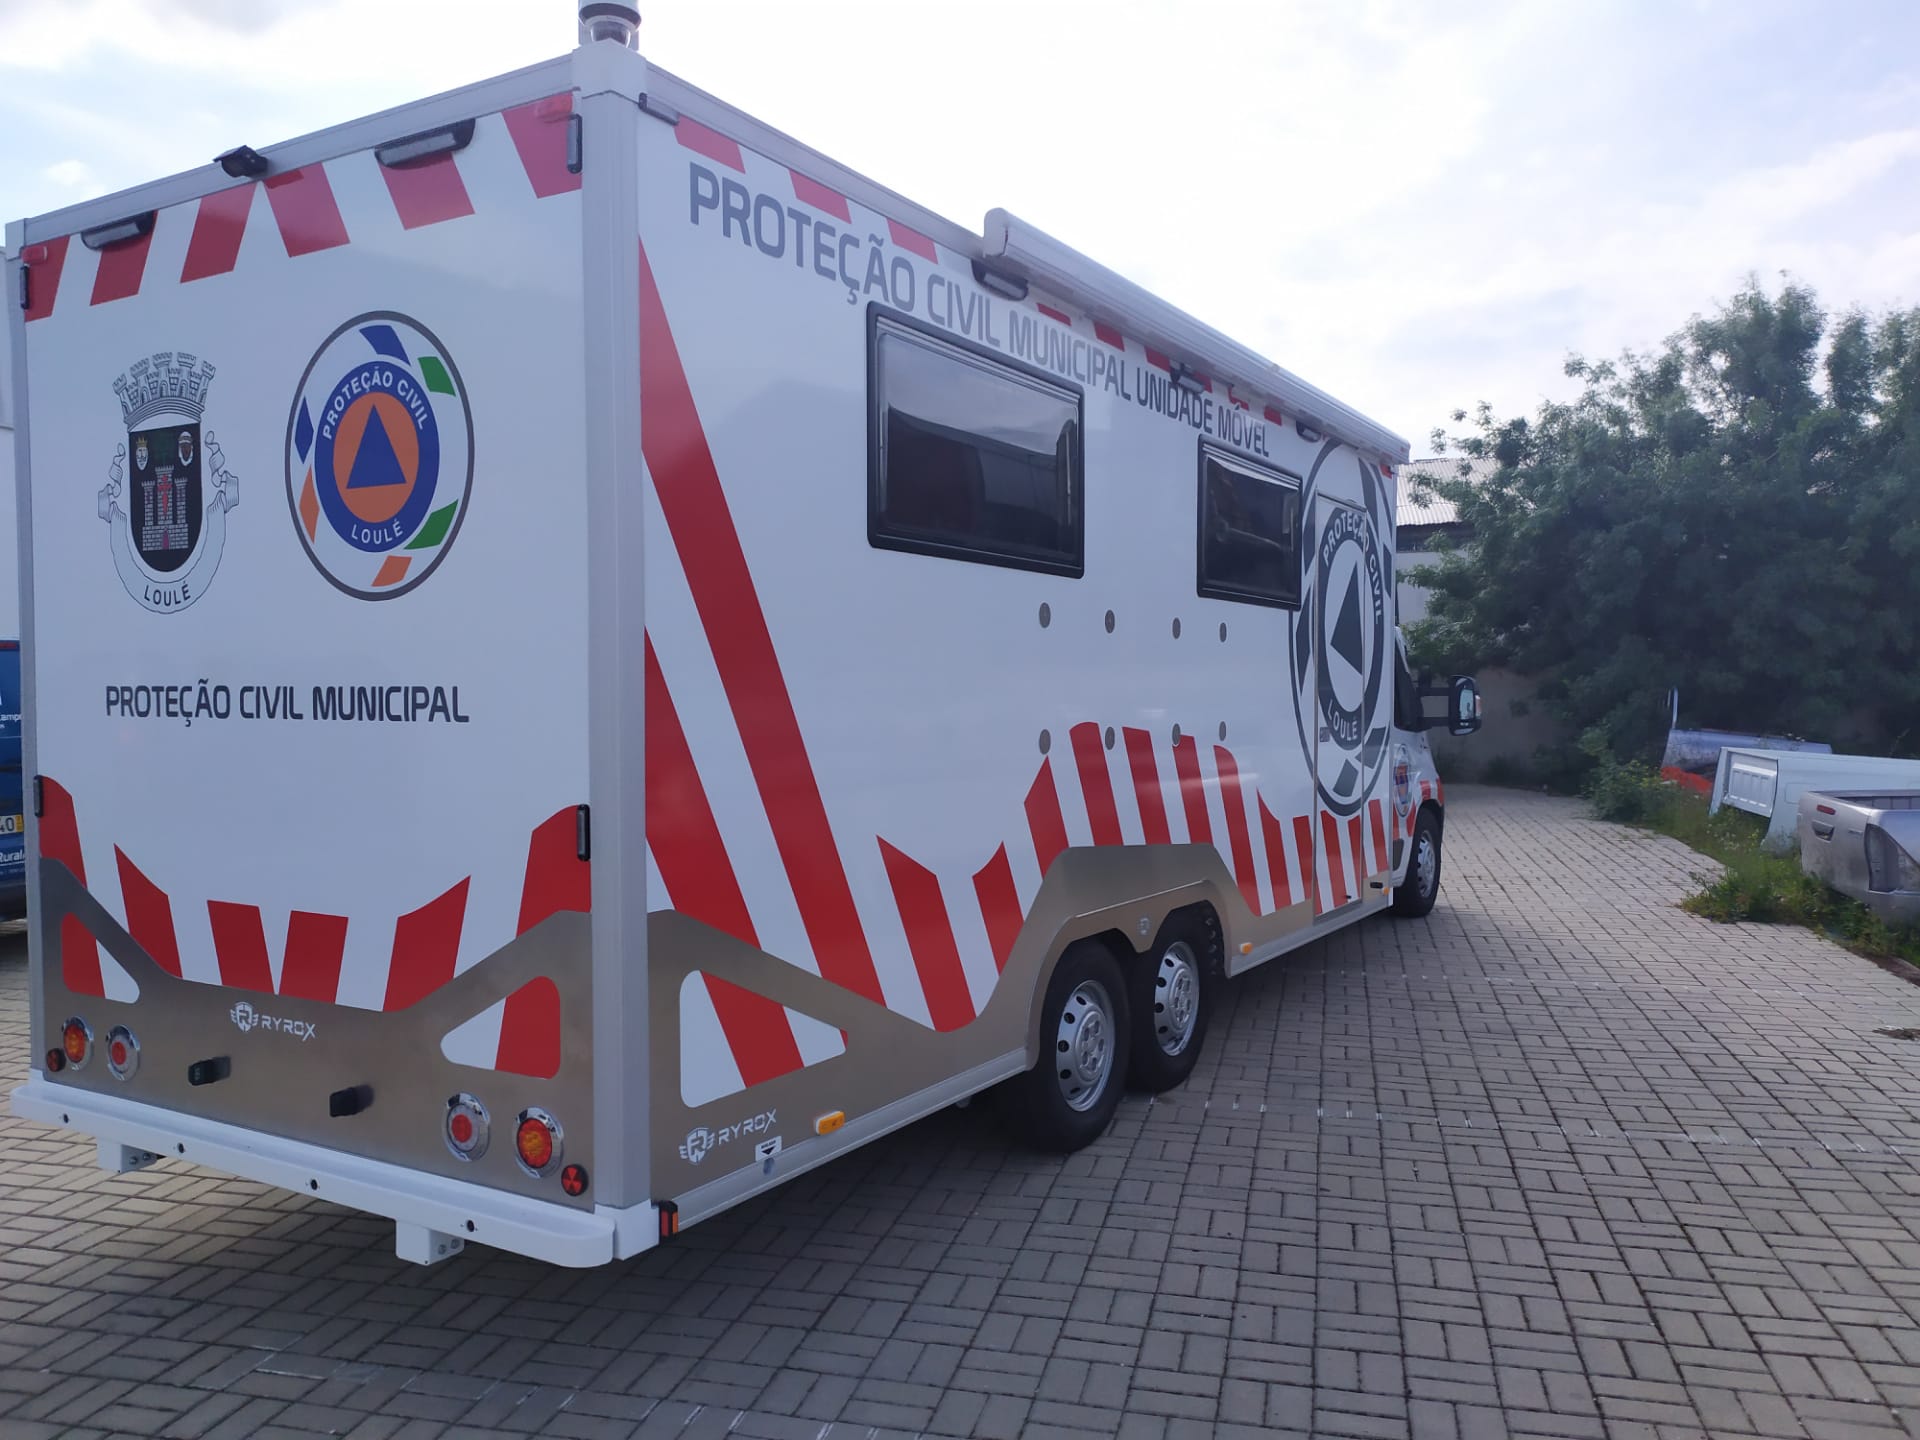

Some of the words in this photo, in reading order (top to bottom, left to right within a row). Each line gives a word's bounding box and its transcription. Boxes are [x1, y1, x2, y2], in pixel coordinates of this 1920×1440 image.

[689, 161, 916, 313] PROTEÇÃO
[927, 273, 1000, 348] CIVIL
[1008, 309, 1132, 402] MUNICIPAL
[1136, 367, 1213, 434] UNIDADE
[1218, 404, 1269, 458] MÓVEL
[322, 366, 394, 441] PROTEÇÃO
[397, 379, 429, 430] CIVIL
[351, 517, 404, 545] LOULÉ
[1322, 511, 1370, 568] PROTEÇÃO
[1369, 553, 1382, 625] CIVIL
[143, 580, 191, 607] LOULÉ
[105, 678, 231, 727] PROTEÇÃO
[239, 685, 304, 720] CIVIL
[312, 685, 470, 723] MUNICIPAL
[1327, 699, 1358, 741] LOULÉ
[261, 1014, 316, 1042] RYROX
[718, 1108, 777, 1146] RYROX
